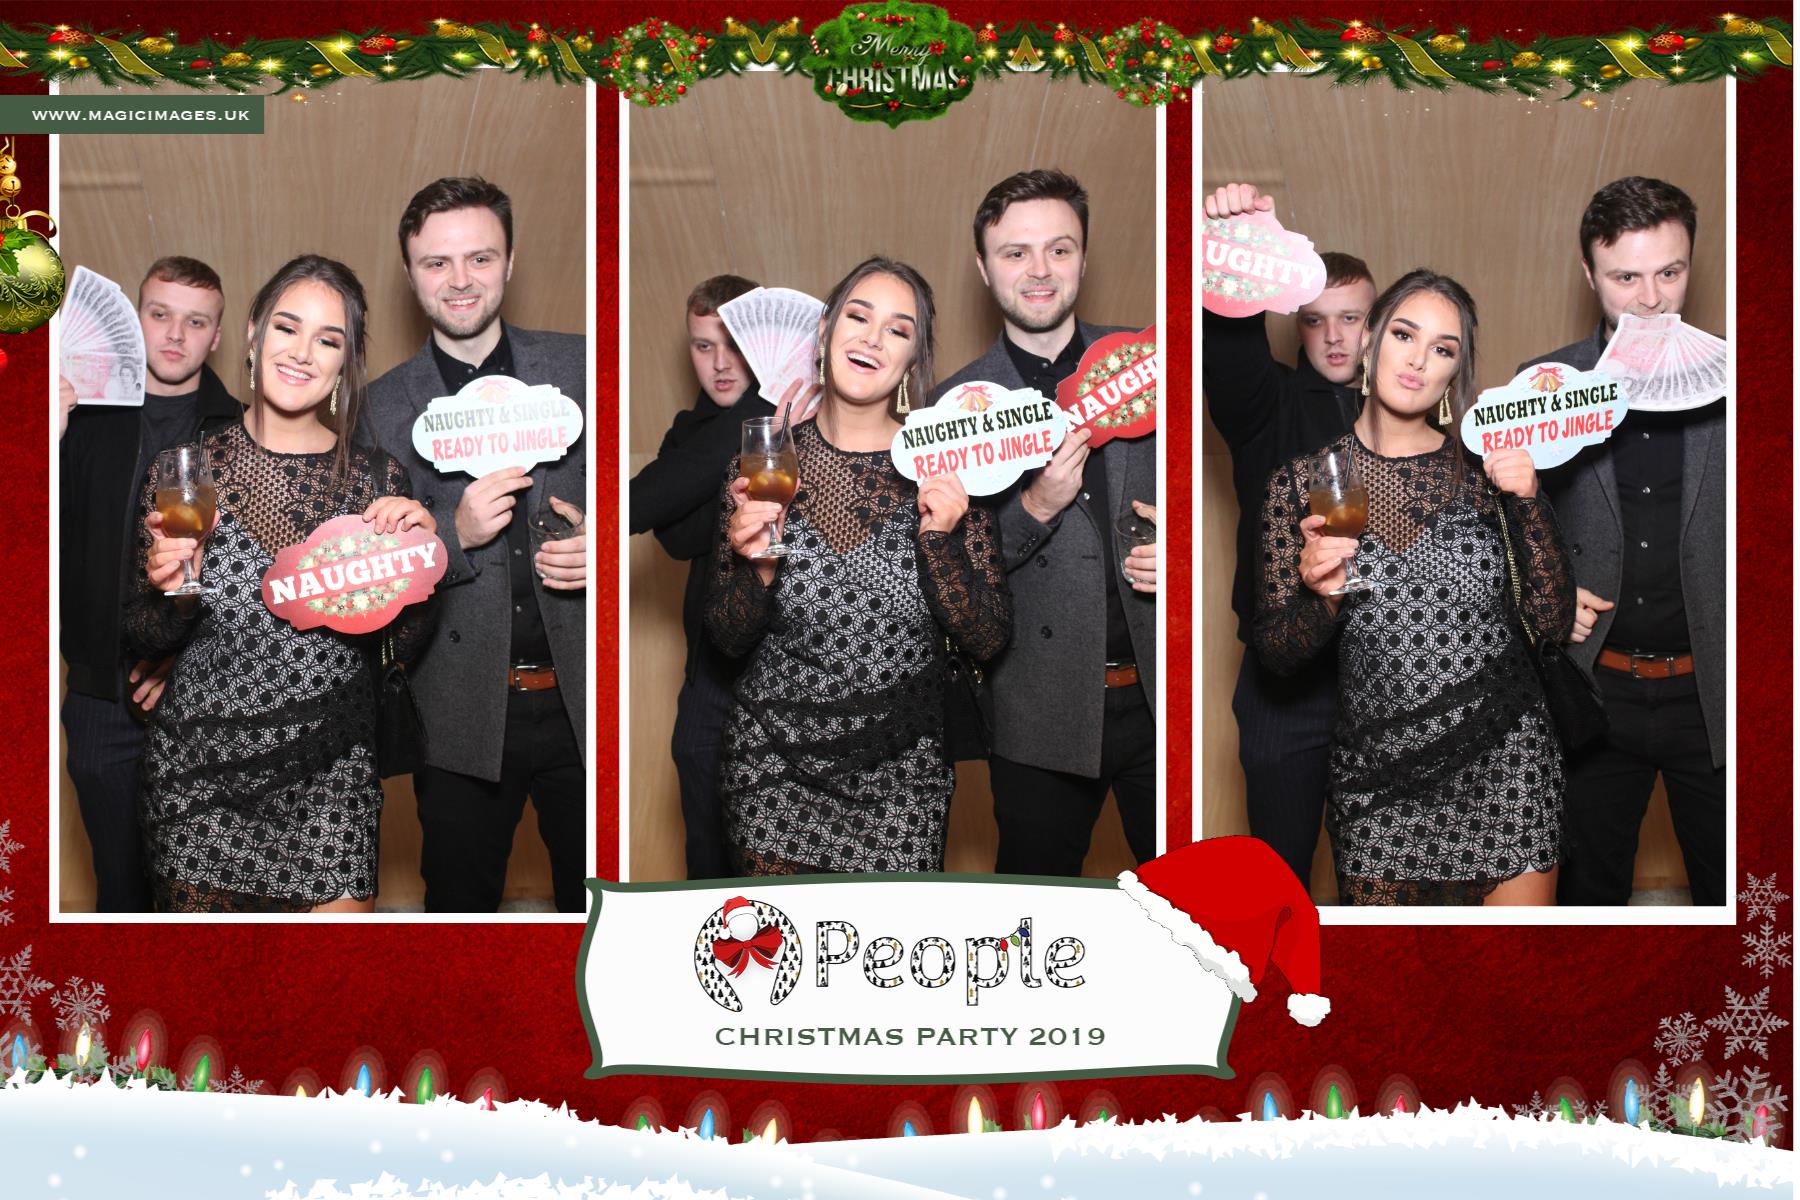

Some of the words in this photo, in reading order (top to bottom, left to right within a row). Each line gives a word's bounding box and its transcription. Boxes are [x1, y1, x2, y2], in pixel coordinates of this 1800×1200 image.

[423, 407, 495, 433] NAUGHTY
[500, 408, 511, 424] &
[513, 399, 570, 422] SINGLE
[901, 415, 979, 450] NAUGHTY
[982, 413, 995, 433] &
[996, 401, 1053, 430] SINGLE
[1473, 396, 1547, 427] NAUGHTY
[1550, 393, 1562, 412] &
[1565, 383, 1618, 409] SINGLE
[432, 434, 484, 461] READY
[487, 432, 509, 455] TO
[513, 426, 568, 452] JINGLE
[1482, 426, 1534, 454] READY
[1537, 420, 1558, 442] TO
[1562, 409, 1614, 440] JINGLE
[913, 448, 968, 479] READY
[972, 442, 995, 468] TO
[998, 430, 1054, 462] JINGLE
[269, 542, 437, 605] NAUGHTY
